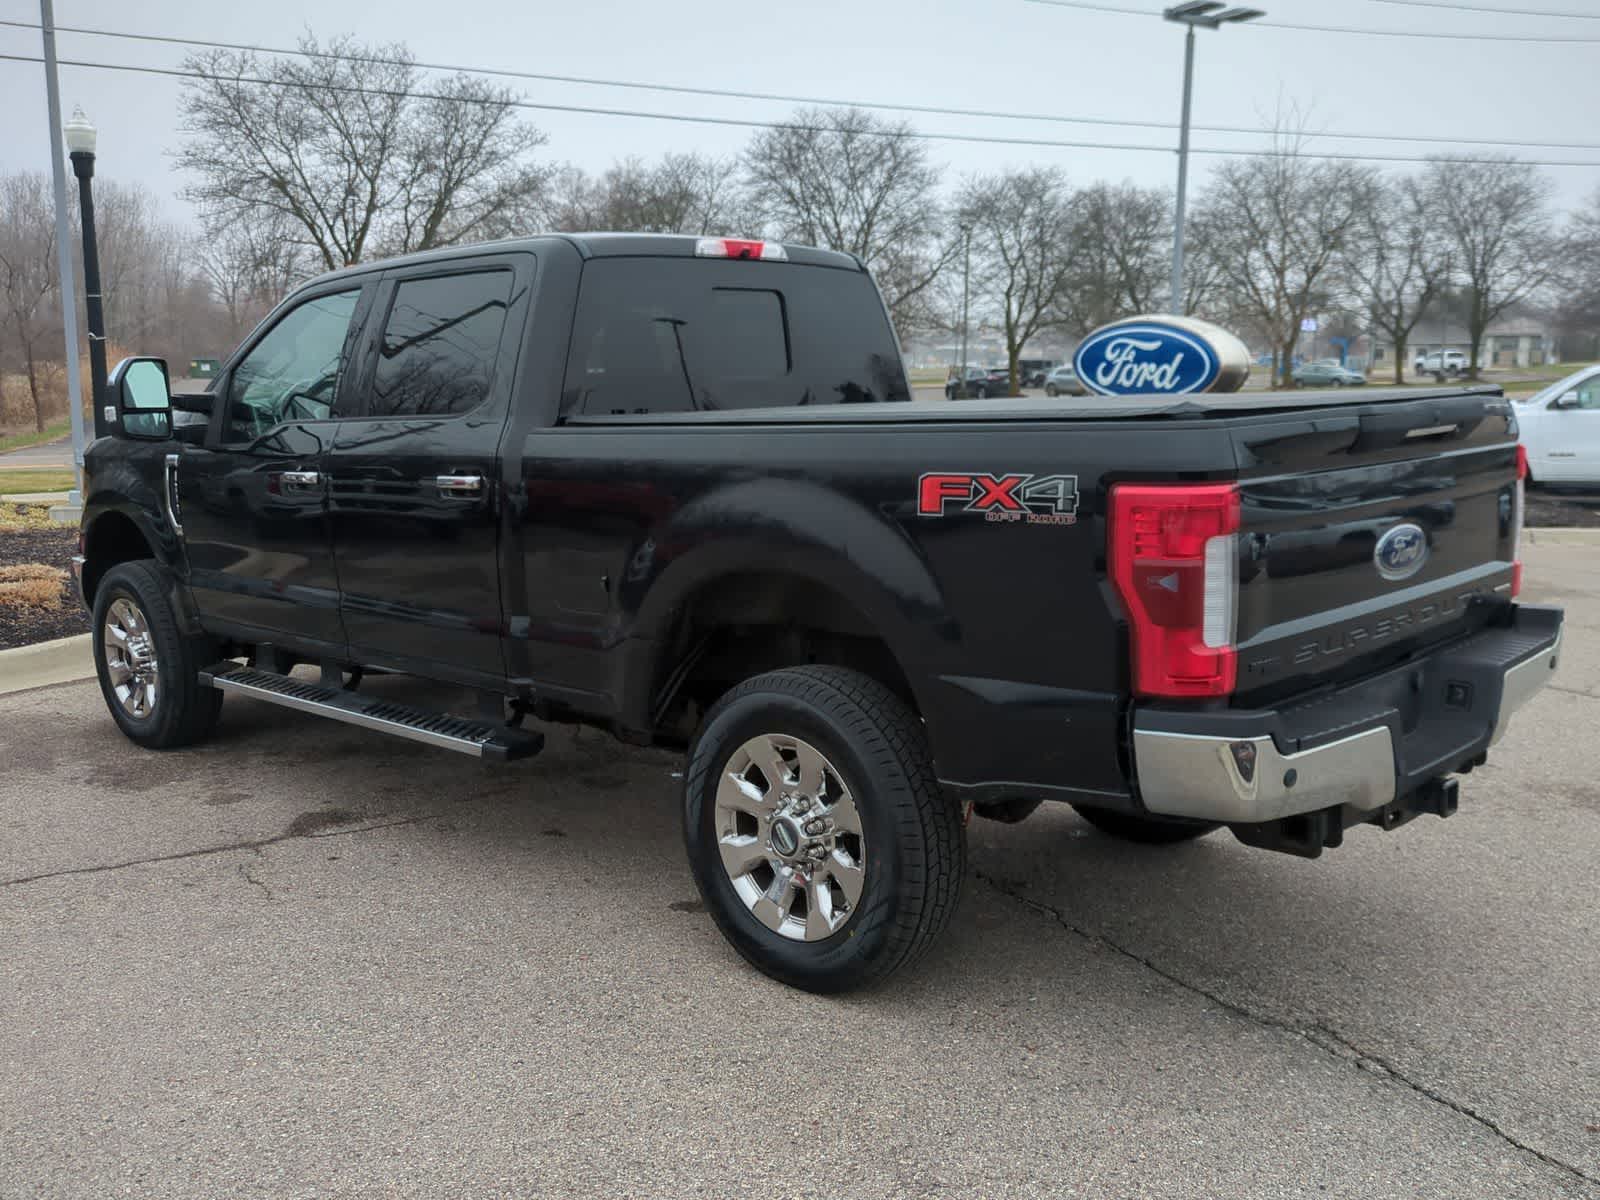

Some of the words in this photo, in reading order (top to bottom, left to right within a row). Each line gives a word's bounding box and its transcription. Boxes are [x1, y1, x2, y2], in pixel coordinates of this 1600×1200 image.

[1096, 337, 1184, 390] Ford
[917, 472, 1079, 516] FX4
[1294, 614, 1413, 665] SUPER
